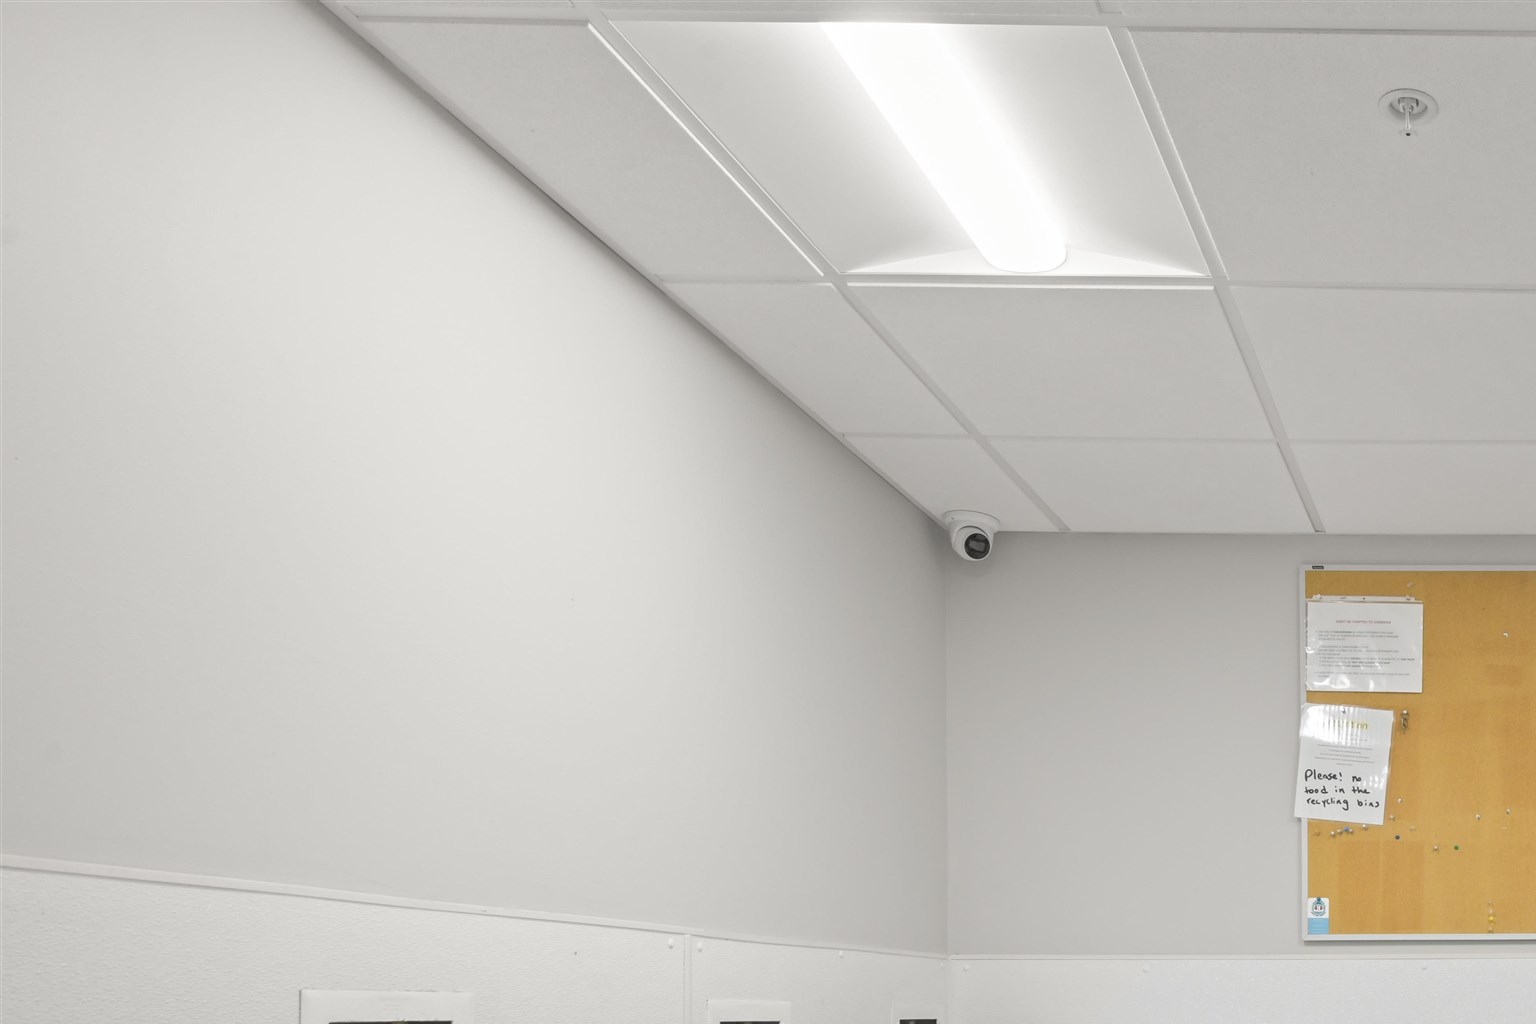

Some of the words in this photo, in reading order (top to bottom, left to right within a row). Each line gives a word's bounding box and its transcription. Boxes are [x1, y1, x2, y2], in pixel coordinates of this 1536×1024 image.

[1304, 769, 1343, 782] Please!
[1352, 775, 1362, 783] no
[1334, 785, 1346, 794] in
[1351, 785, 1371, 795] the
[1306, 797, 1350, 811] recycling
[1357, 799, 1380, 808] bins
